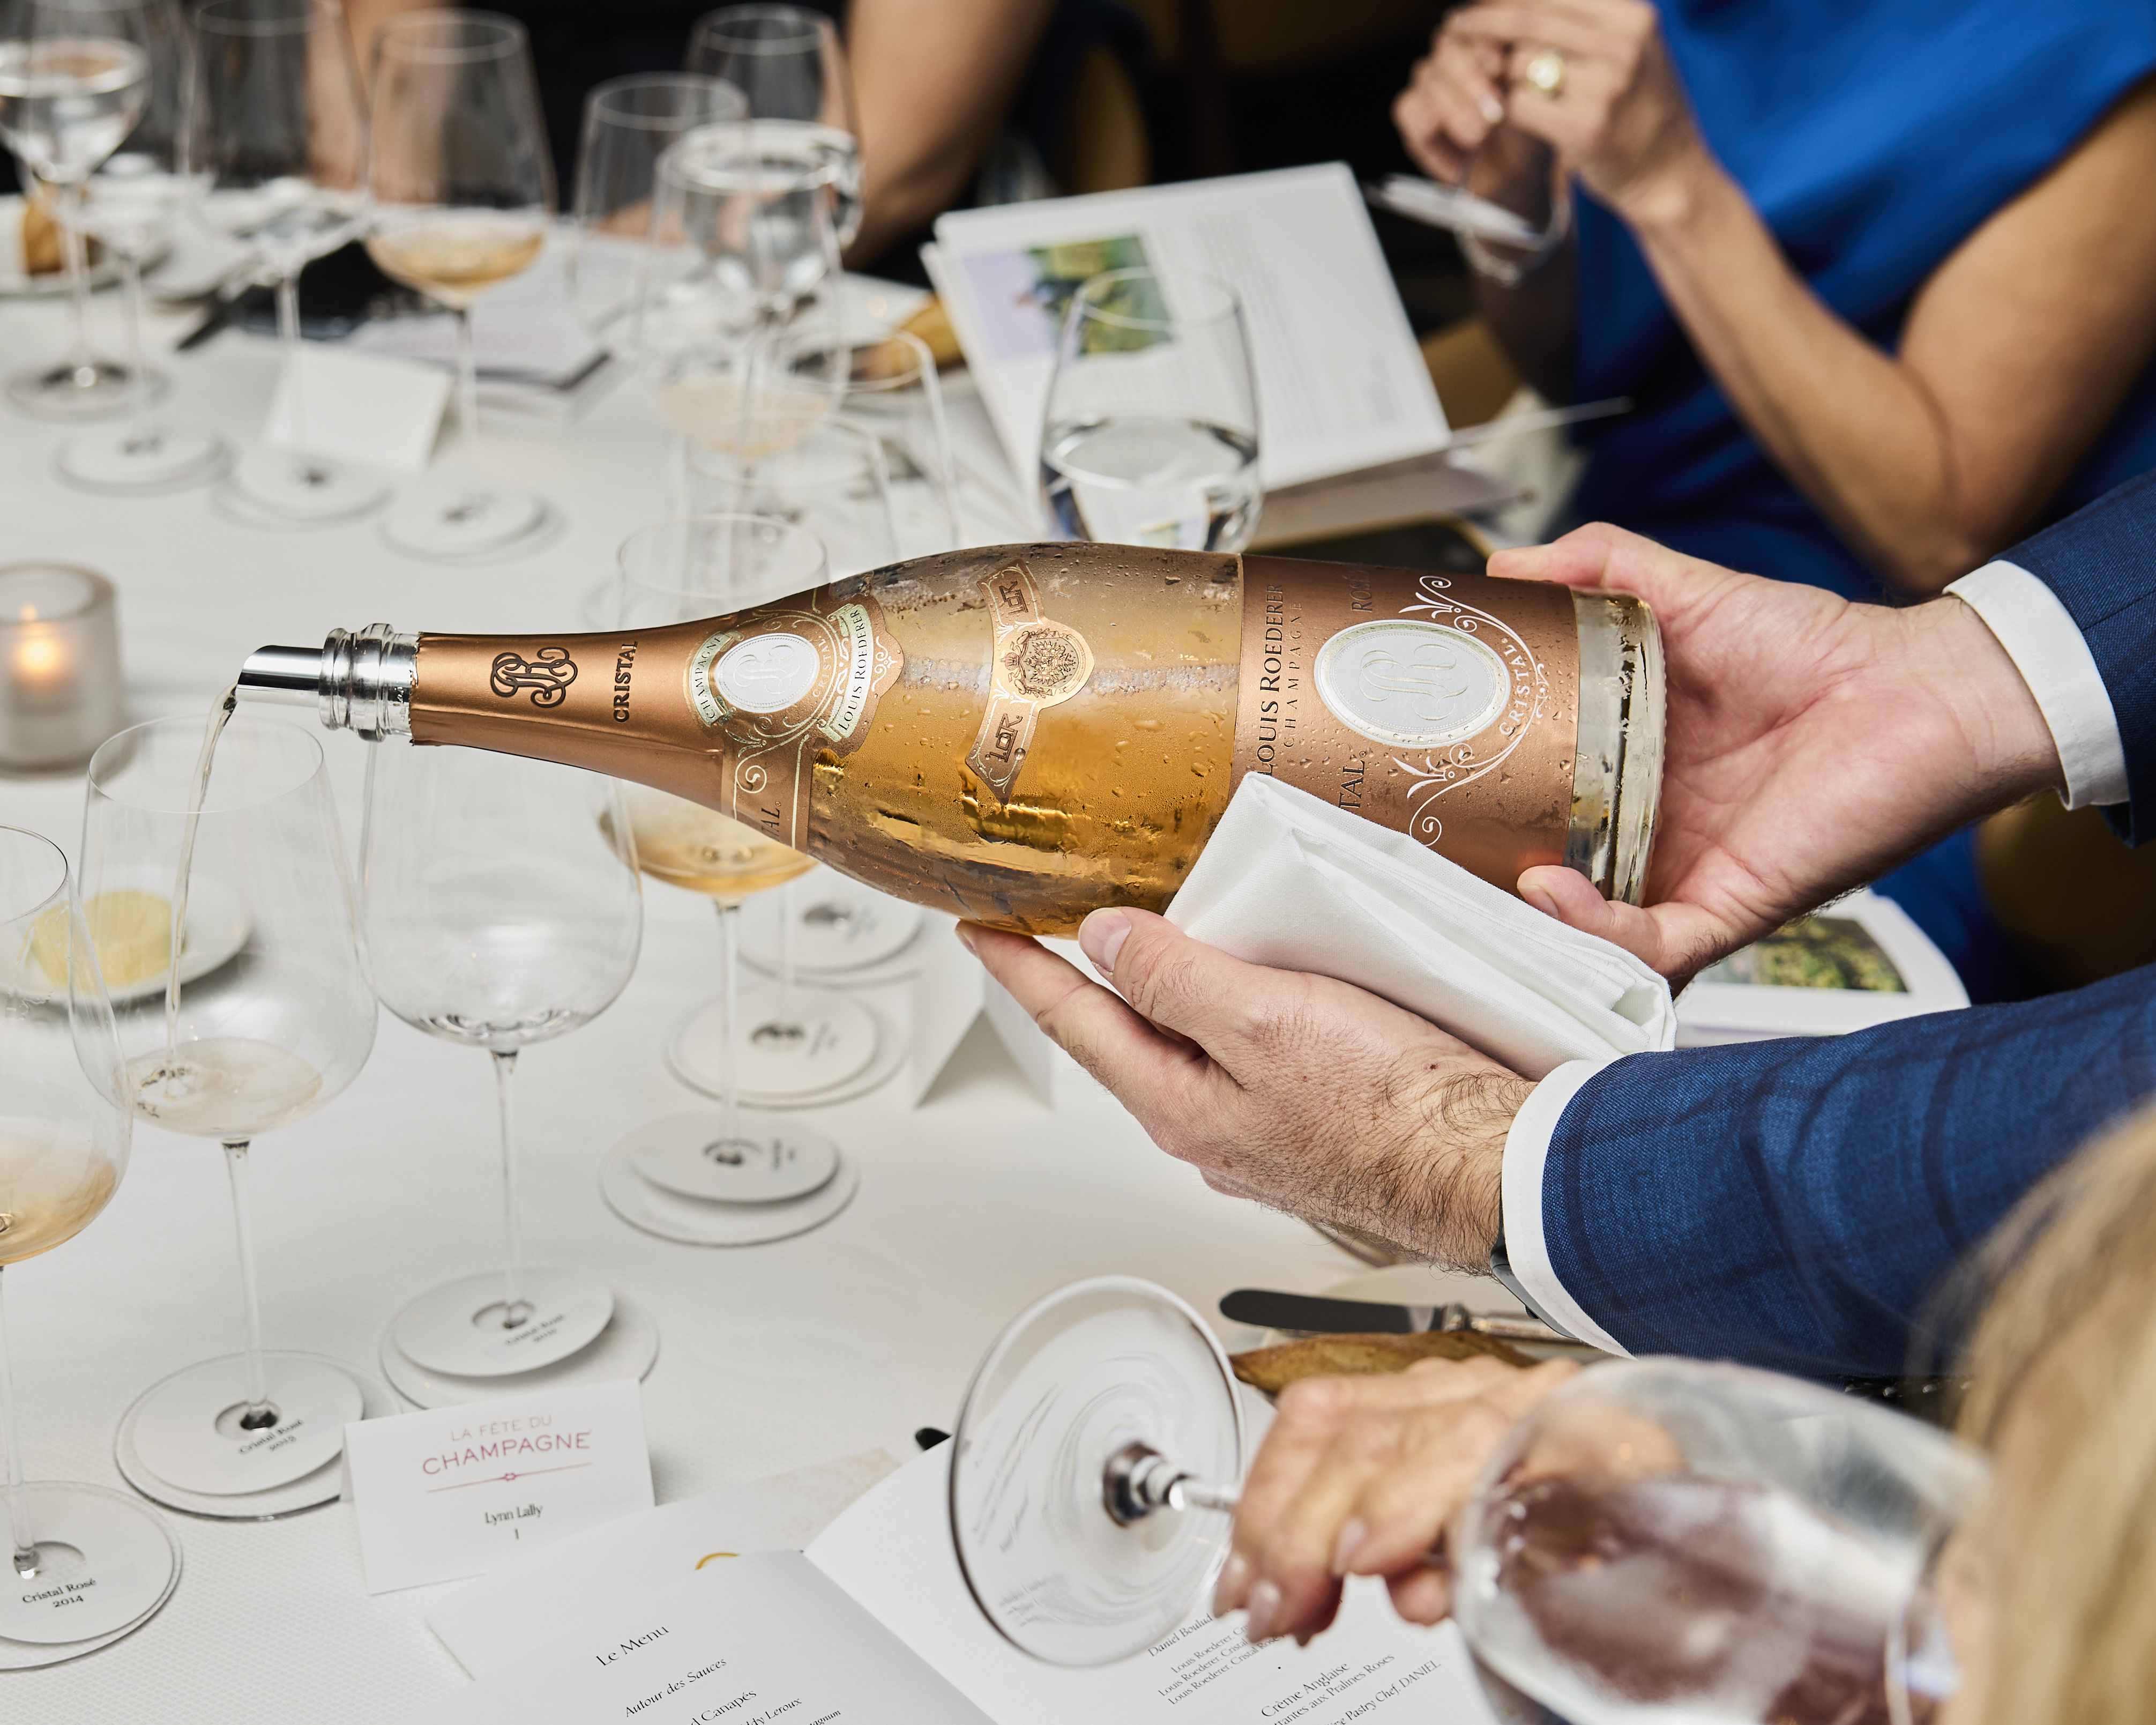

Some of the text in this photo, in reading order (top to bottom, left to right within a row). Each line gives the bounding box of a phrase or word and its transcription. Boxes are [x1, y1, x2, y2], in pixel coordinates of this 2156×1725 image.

[613, 641, 638, 723] CRISTAL
[695, 636, 723, 719] CHAMPAGNE
[812, 638, 831, 697] CRISTAL
[838, 609, 868, 731] LOUIS ROEDERER
[1255, 584, 1284, 776] LOUIS ROEDERER
[1284, 603, 1302, 747] CHAMPAGNE
[1499, 644, 1530, 735] CRISTAL
[423, 1432, 591, 1475] CHAMPAGNE
[451, 1415, 553, 1441] LA FÊTE DU
[485, 1503, 543, 1526] Lynn Lally
[23, 1578, 96, 1603] Cristal Rosé
[53, 1595, 84, 1608] 2014
[596, 1626, 669, 1666] Le Menu
[1147, 1613, 1213, 1656] Daniel Boulud
[626, 1659, 727, 1717] Autour des Sauces
[1158, 1681, 1183, 1696] Louis
[1220, 1638, 1249, 1657] Cristal
[1167, 1689, 1193, 1705] Louis
[1230, 1647, 1259, 1665] Cristal
[1171, 1657, 1196, 1674] Louis
[1261, 1663, 1351, 1717] Crème Anglaise
[1309, 1694, 1329, 1708] aux
[1326, 1671, 1366, 1696] Pralines
[1363, 1654, 1394, 1674] Roses
[1345, 1700, 1377, 1720] Pastry
[1399, 1660, 1442, 1688] DANIEL
[701, 1690, 757, 1721] Canapés
[765, 1698, 802, 1719] Leroux
